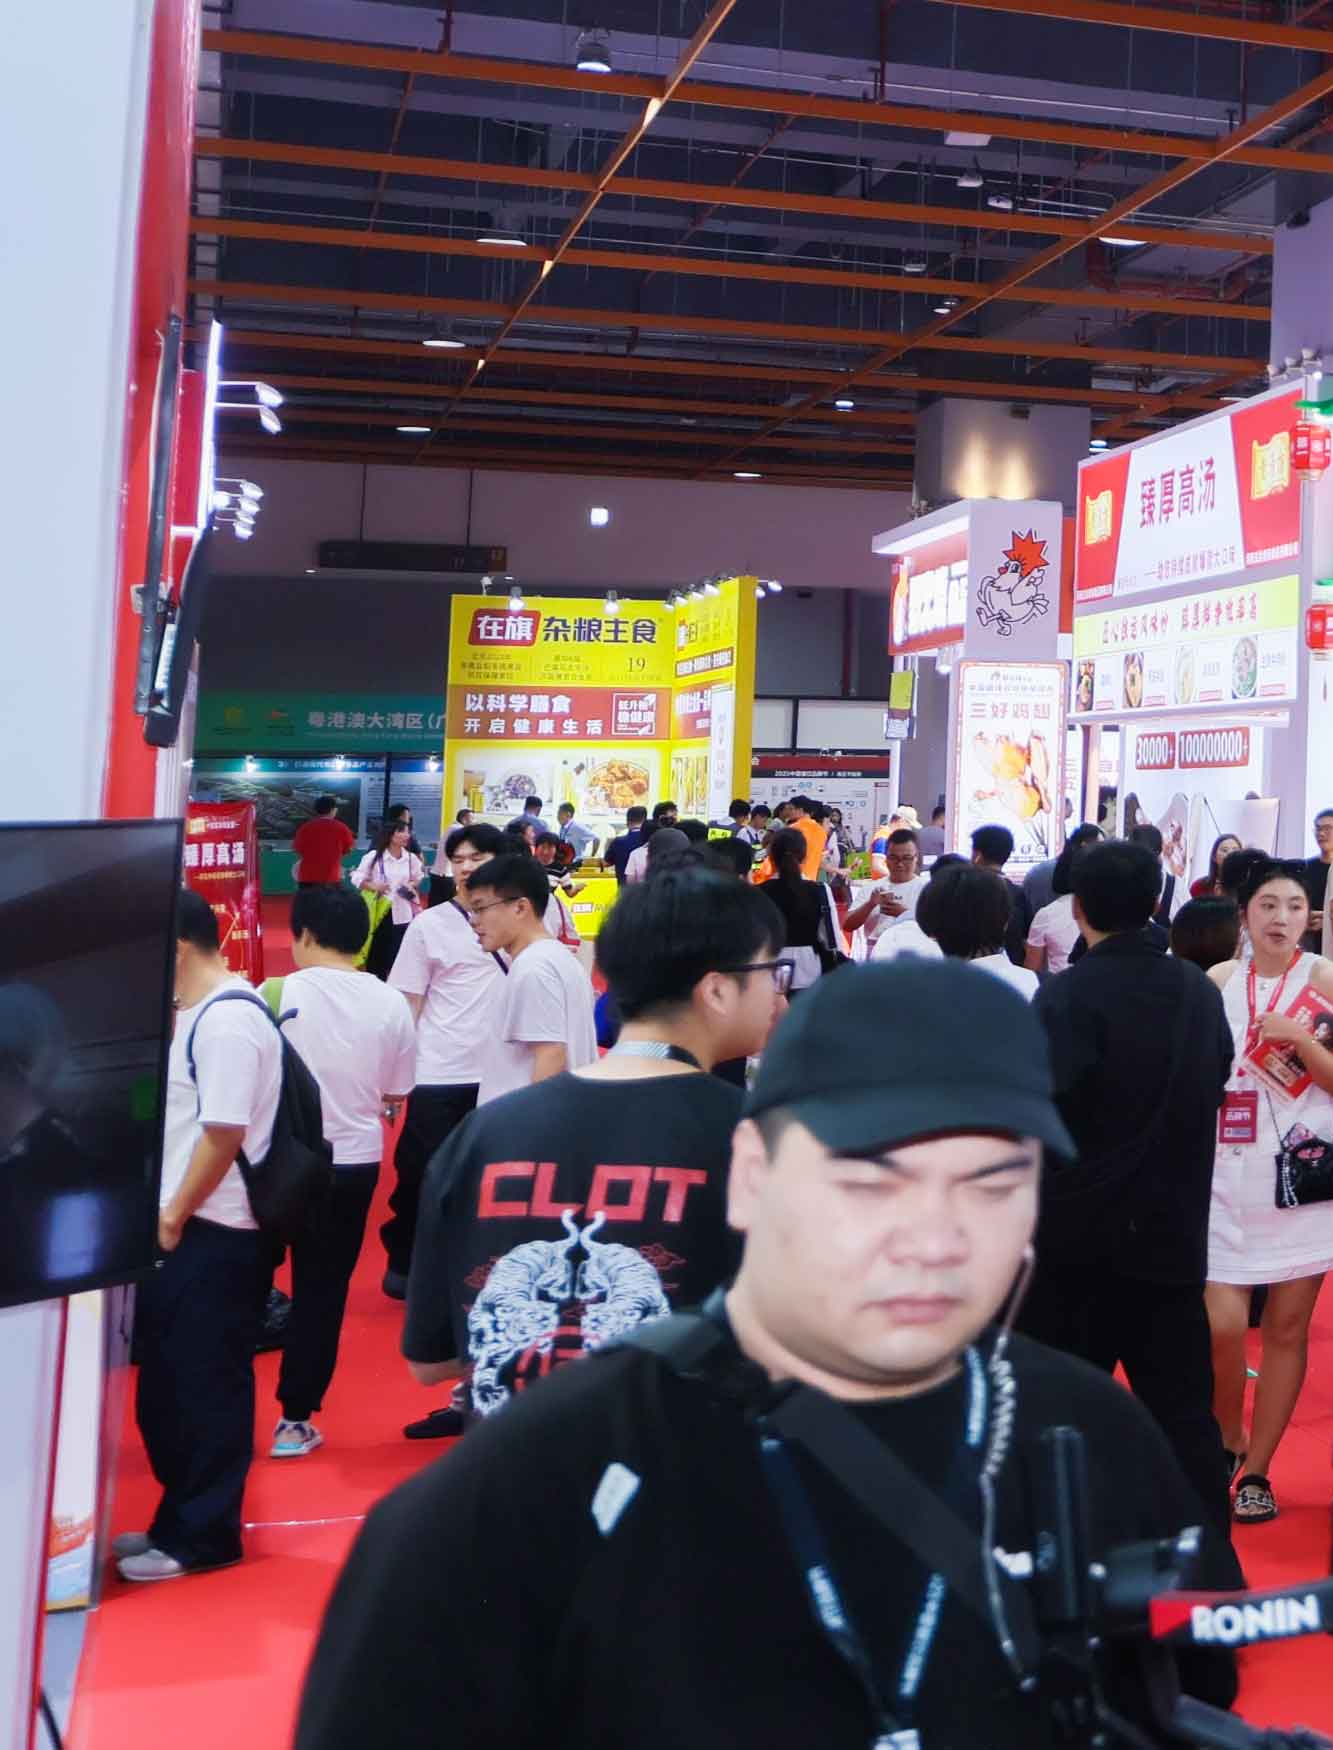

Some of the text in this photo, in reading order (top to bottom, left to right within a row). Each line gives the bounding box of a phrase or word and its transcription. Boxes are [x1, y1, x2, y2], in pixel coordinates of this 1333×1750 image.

[1139, 455, 1216, 528] 臻厚高汤
[476, 614, 657, 644] 在旗 杂粮主食
[627, 656, 646, 673] 19
[464, 692, 572, 713] 以科学膳食
[464, 718, 603, 736] 开启健康生活
[476, 1160, 707, 1223] CLOT
[1190, 1595, 1320, 1644] RONIN
